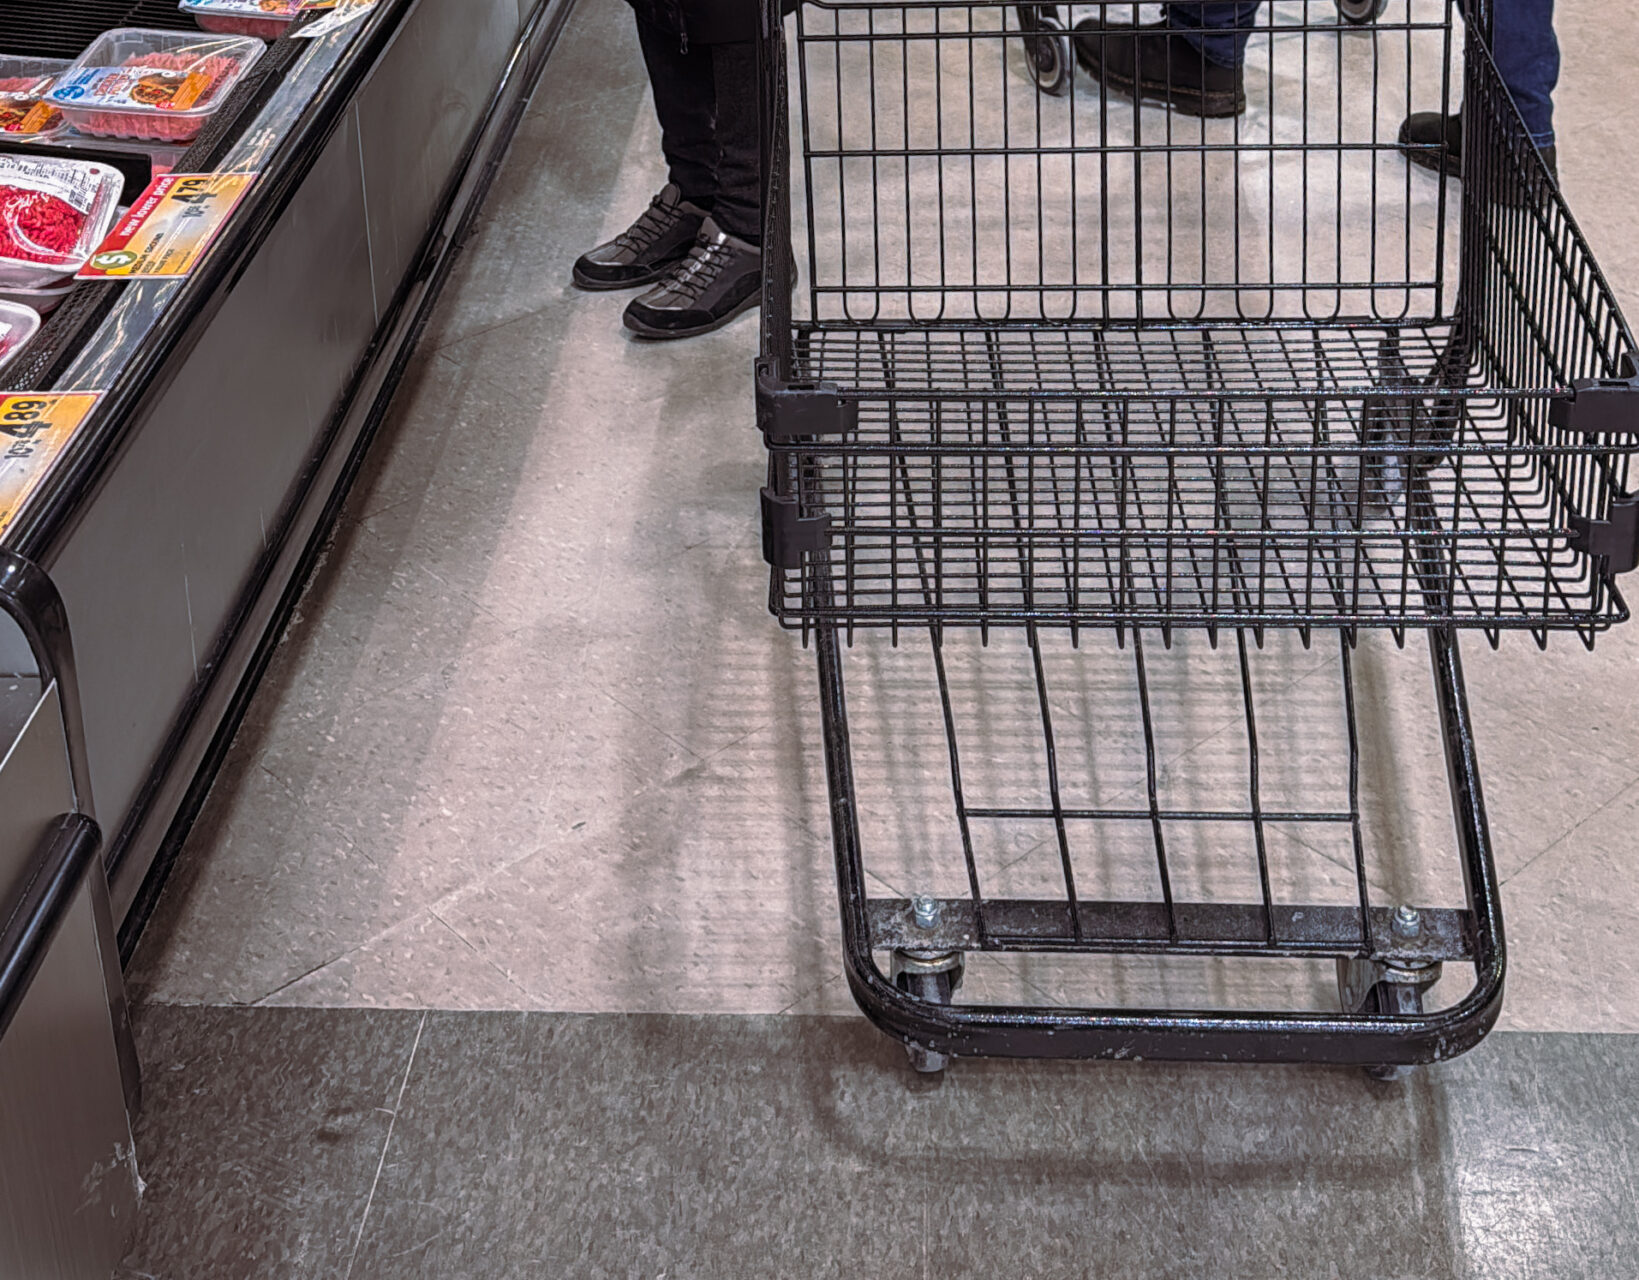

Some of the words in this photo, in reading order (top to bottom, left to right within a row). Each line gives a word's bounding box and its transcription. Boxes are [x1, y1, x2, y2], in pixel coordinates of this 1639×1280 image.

[119, 217, 140, 237] new
[131, 197, 158, 218] lower
[152, 177, 174, 195] price
